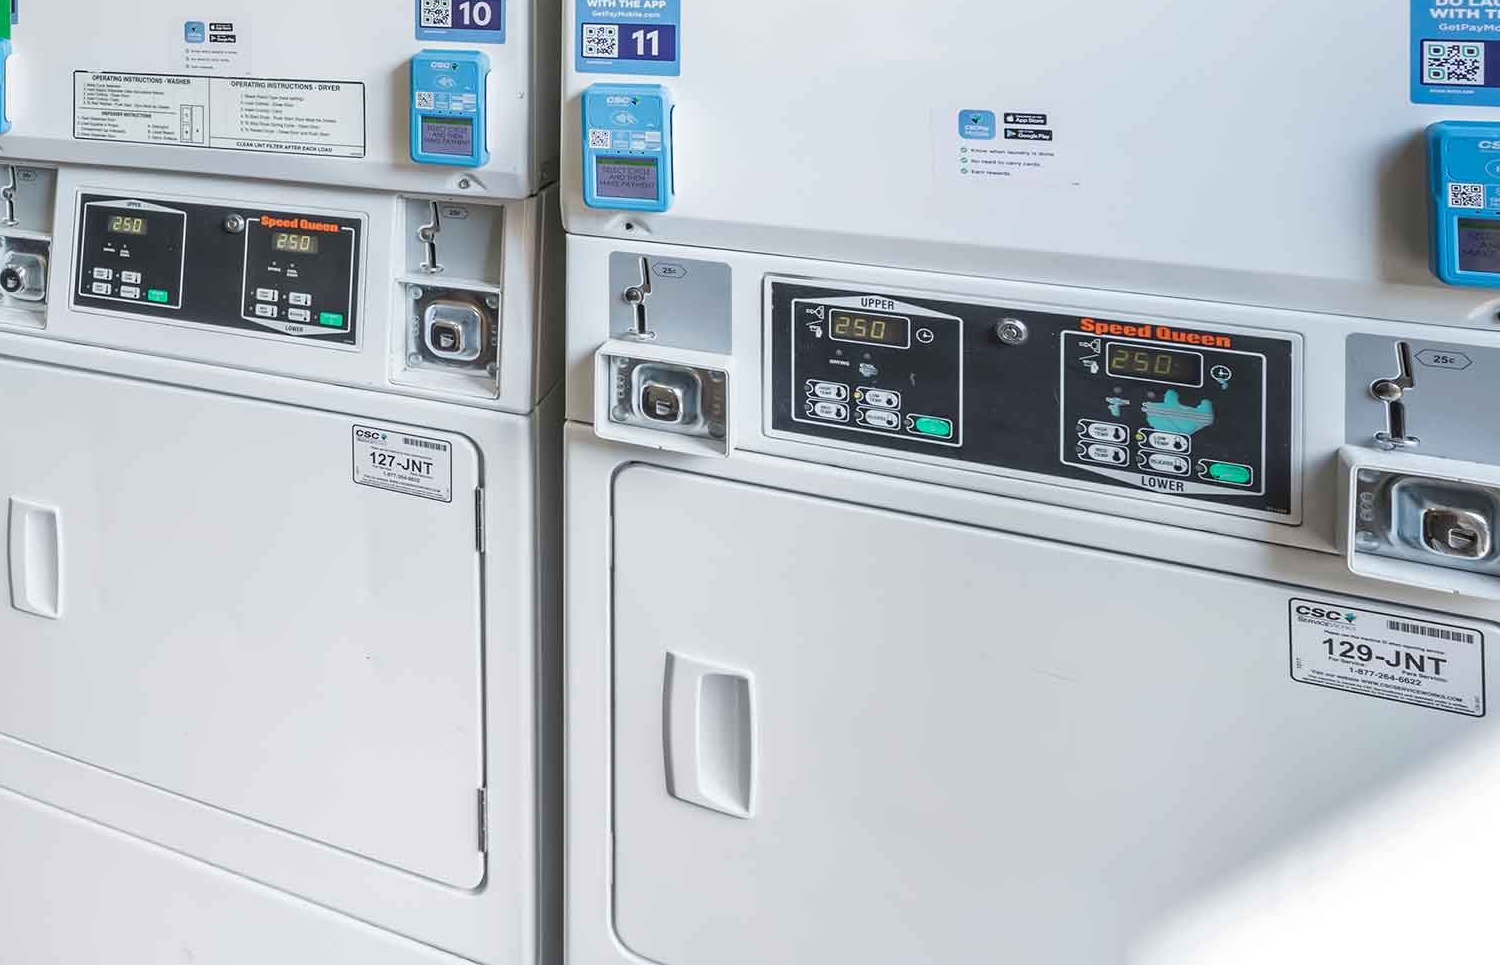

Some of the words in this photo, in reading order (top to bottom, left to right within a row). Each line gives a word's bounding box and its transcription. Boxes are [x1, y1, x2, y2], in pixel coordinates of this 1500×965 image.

[586, 0, 617, 8] WITH
[618, 0, 641, 9] THE
[643, 0, 667, 9] APP
[459, 1, 492, 26] 10
[1428, 8, 1480, 19] WITH
[632, 28, 659, 56] 11
[123, 76, 163, 84] INSTRUCTIONS
[230, 80, 266, 89] OPERATING
[267, 82, 314, 91] INSTRUCTIONS
[318, 84, 341, 92] DRYER
[112, 216, 143, 233] 250
[260, 216, 300, 228] Speed
[300, 219, 340, 233] Queen
[276, 234, 311, 251] 250
[860, 298, 896, 311] UPPER
[835, 316, 886, 341] 250
[1080, 316, 1153, 338] Speed
[1156, 326, 1233, 349] Queen
[1111, 350, 1173, 375] 250
[356, 430, 380, 440] CSC
[370, 452, 434, 476] 127-JNT
[1141, 475, 1185, 493] LOWER
[1296, 605, 1342, 621] CSC
[1322, 638, 1447, 676] 129-JNT
[1349, 667, 1423, 686] 1-877-264-6622
